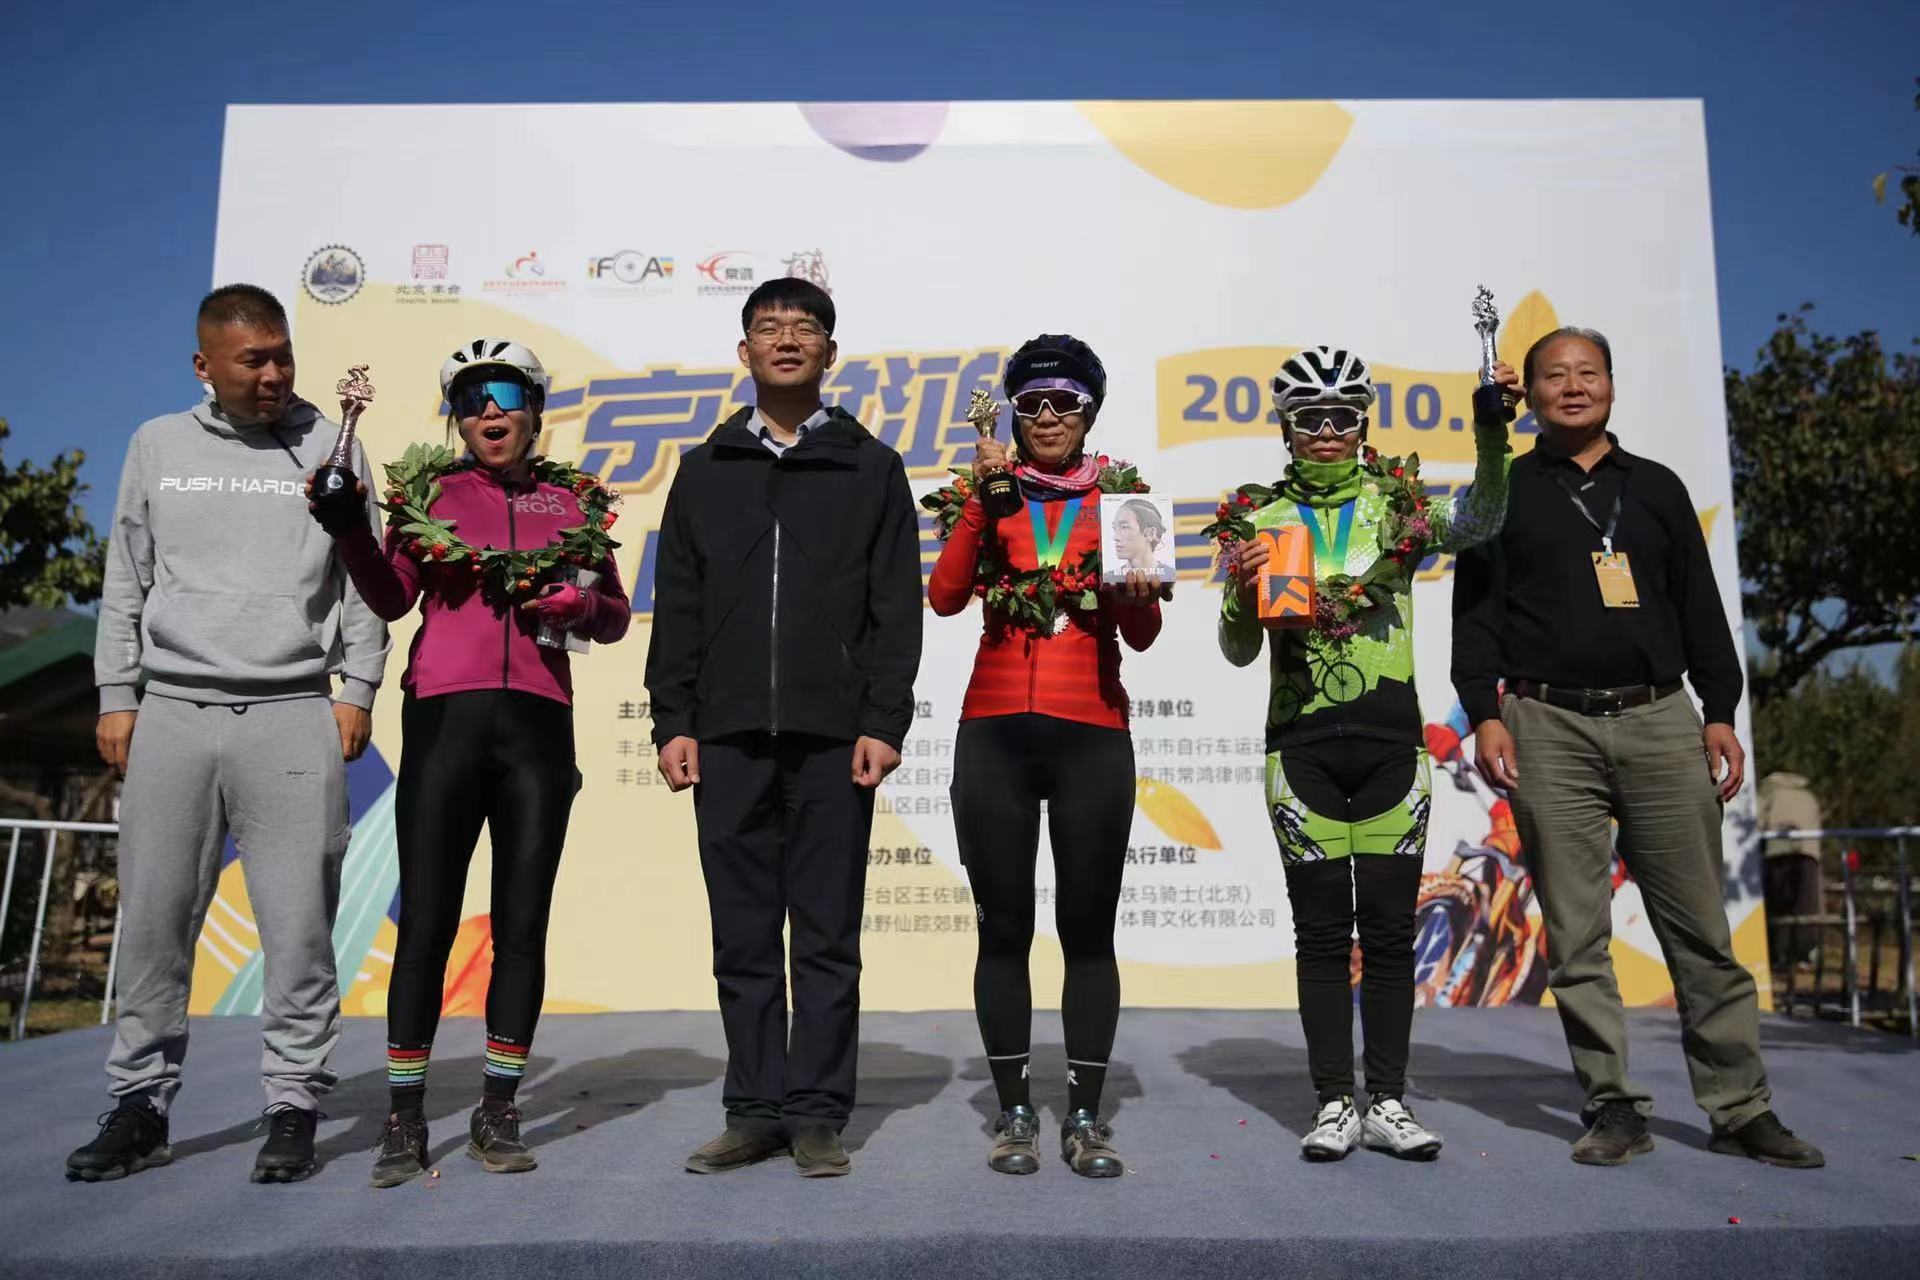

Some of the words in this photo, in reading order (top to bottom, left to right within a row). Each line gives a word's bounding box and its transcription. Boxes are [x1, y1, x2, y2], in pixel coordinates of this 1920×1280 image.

[160, 477, 224, 491] PUSH
[515, 501, 567, 516] ROO
[1120, 908, 1275, 928] 体育文化有限公司
